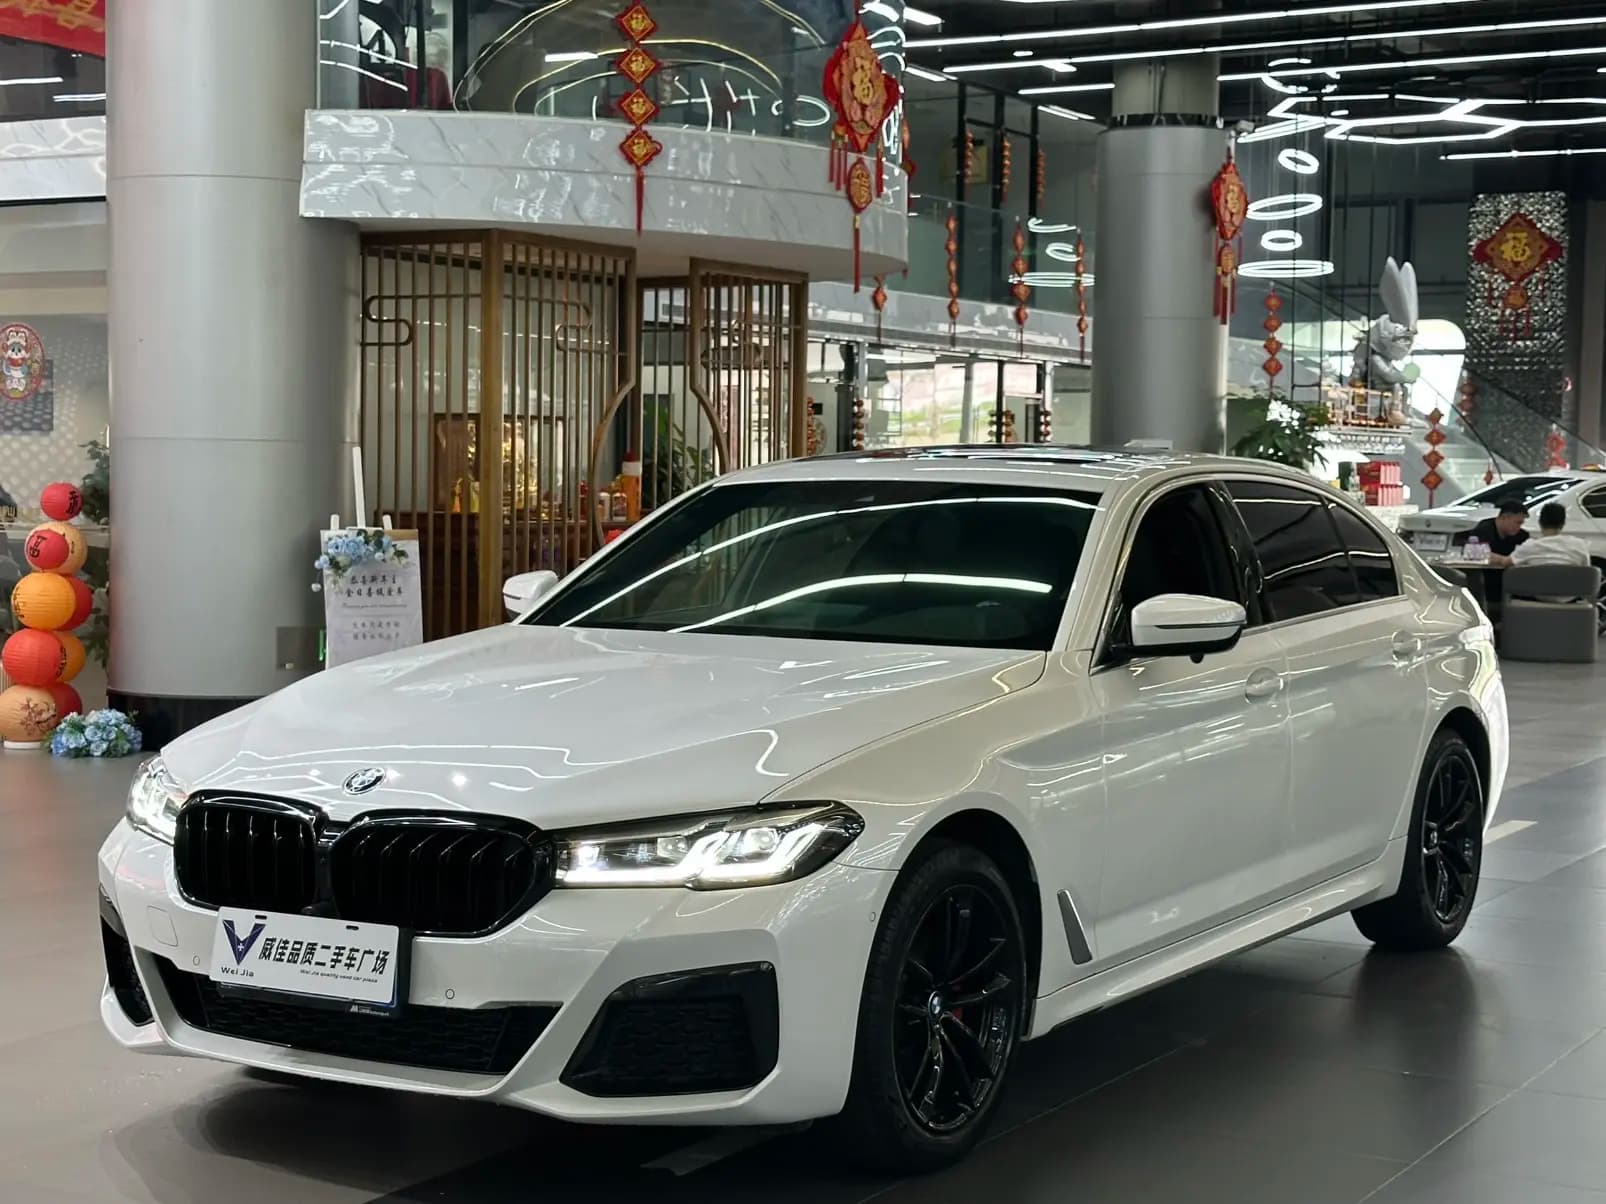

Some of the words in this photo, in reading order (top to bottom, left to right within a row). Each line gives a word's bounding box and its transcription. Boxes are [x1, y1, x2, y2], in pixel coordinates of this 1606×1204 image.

[1501, 232, 1530, 262] 福
[259, 937, 390, 975] 威佳品质二手车广场
[221, 967, 238, 976] Wei
[240, 969, 255, 977] Jia
